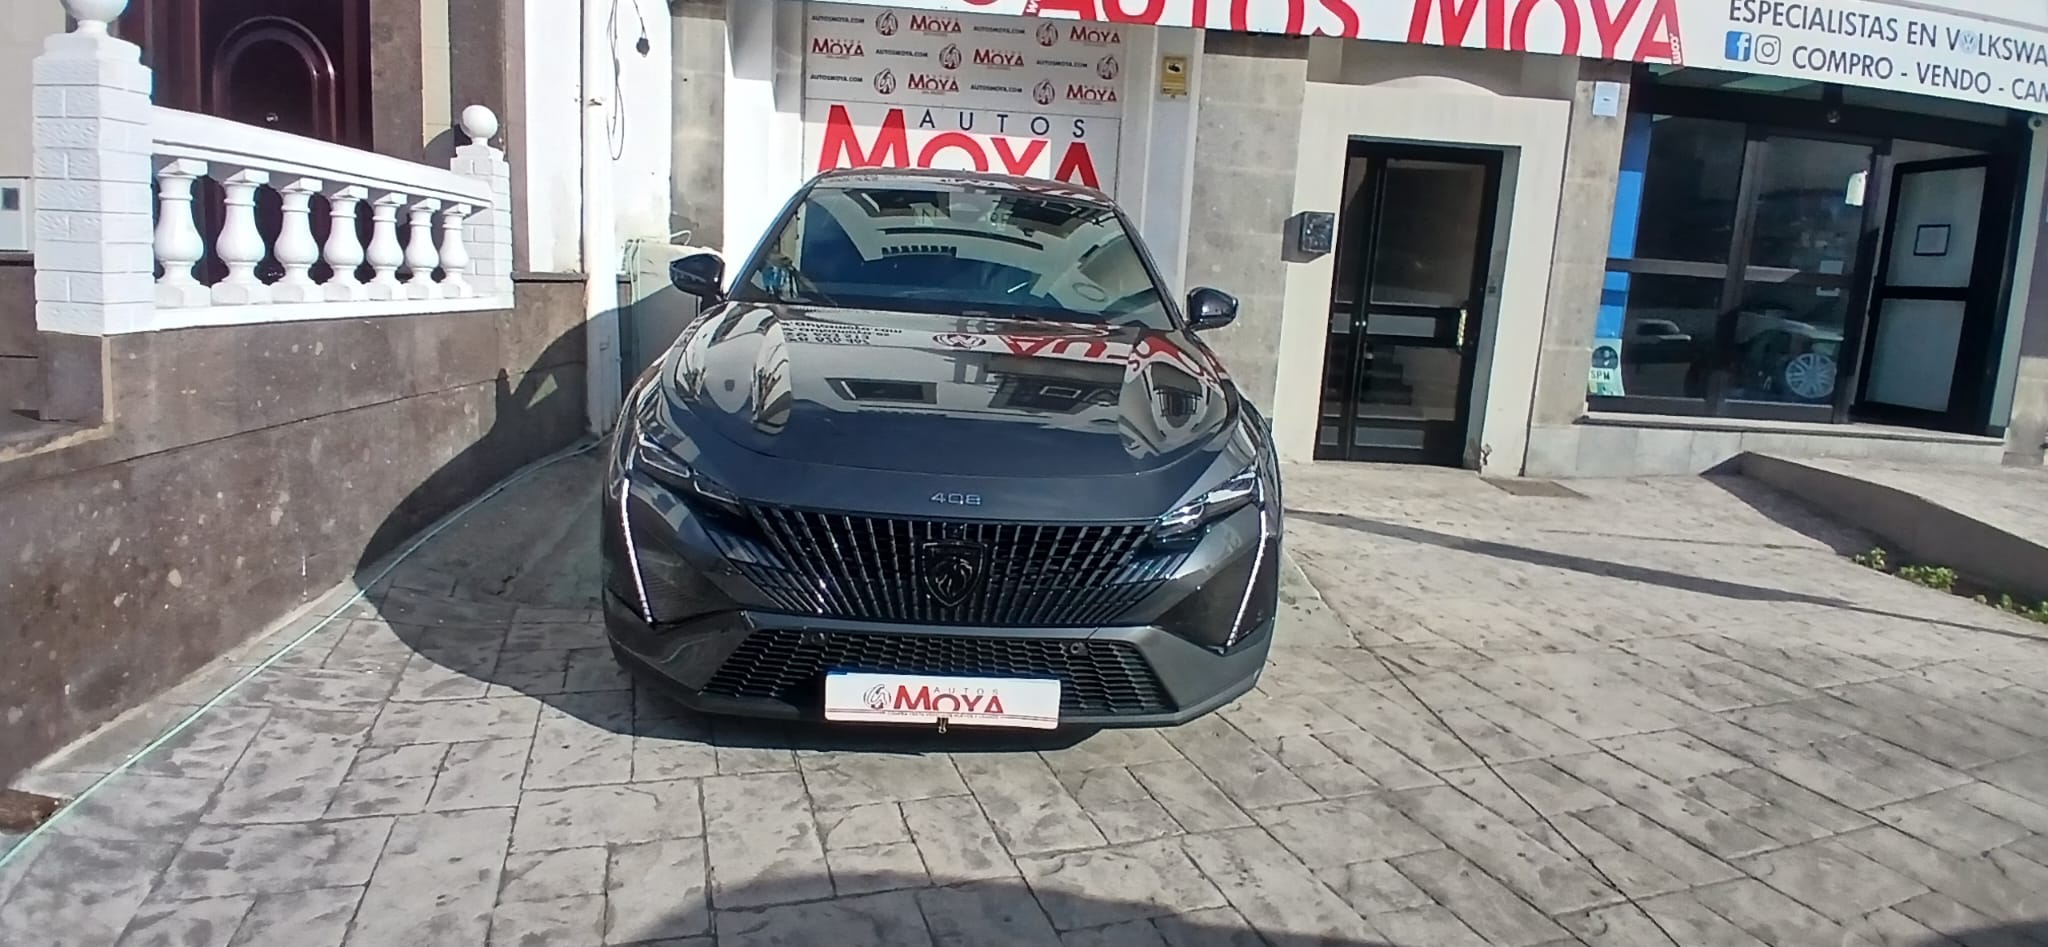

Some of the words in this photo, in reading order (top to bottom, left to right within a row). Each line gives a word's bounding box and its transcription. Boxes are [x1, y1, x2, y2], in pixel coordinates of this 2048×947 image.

[910, 15, 962, 33] MOYA
[1406, 0, 1684, 65] MOYA
[1729, 0, 1898, 42] ESPECIALISTAS
[1907, 21, 1937, 48] EN
[1069, 25, 1121, 43] MOYA
[811, 38, 865, 57] MOYA
[973, 49, 1025, 67] MOYA
[1792, 45, 1894, 80] COMPRO
[1916, 62, 1992, 94] VENDO
[908, 73, 960, 92] MOYA
[1066, 84, 1117, 102] MOYA
[919, 109, 1086, 138] AUTOS
[817, 104, 1101, 190] MOYA
[931, 492, 981, 505] 408
[893, 685, 1004, 713] MOYA
[934, 687, 999, 695] AUTOS
